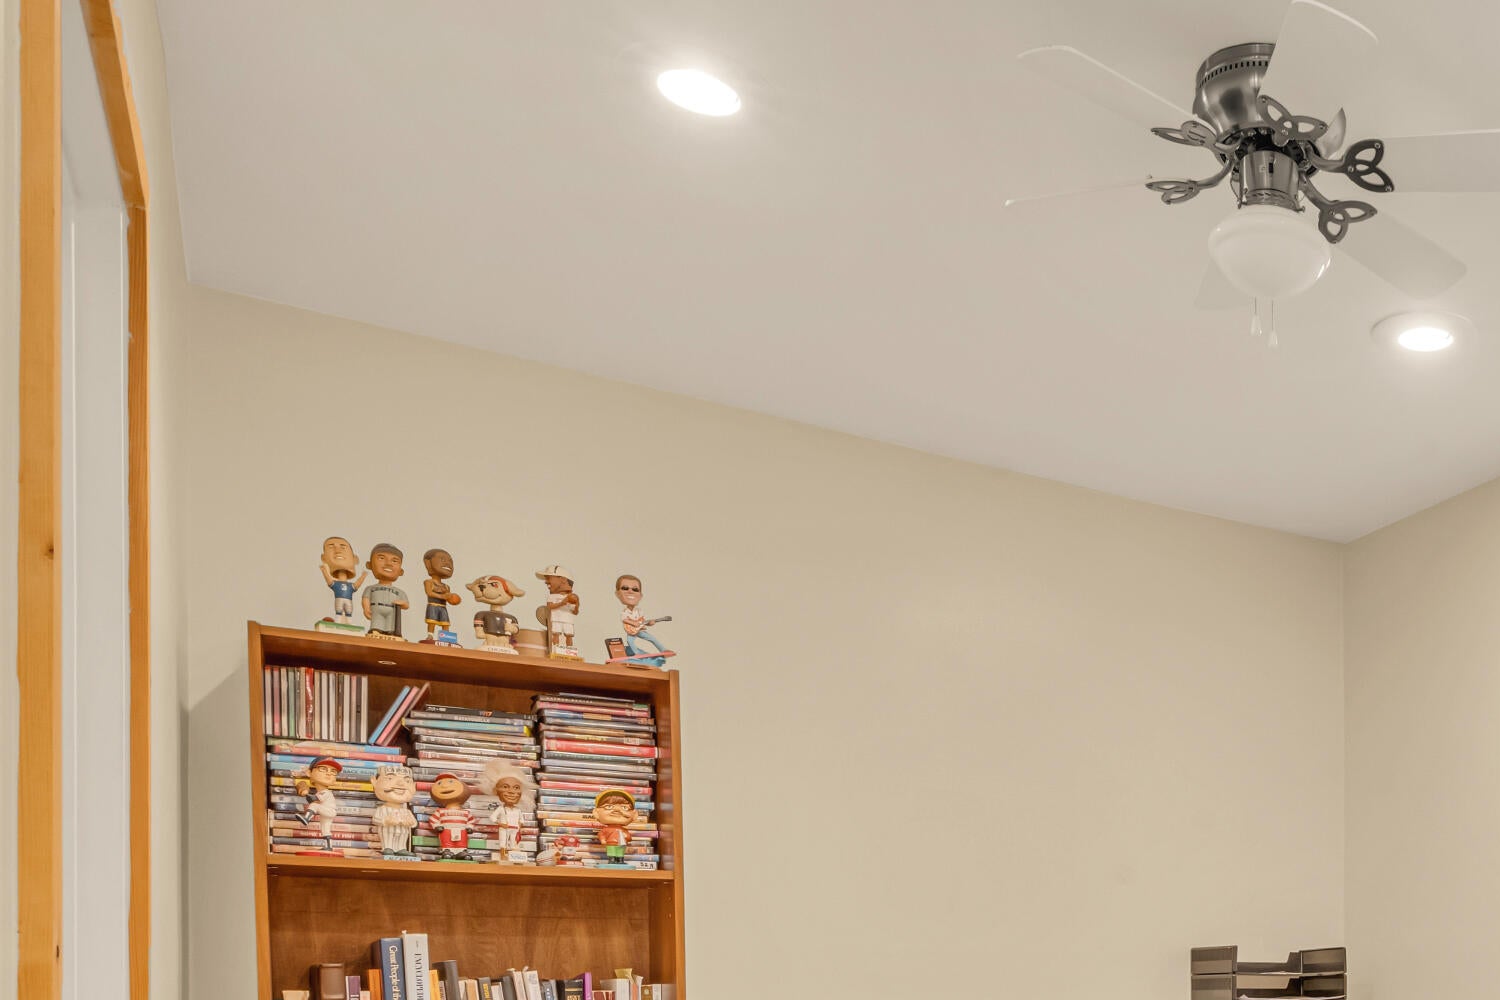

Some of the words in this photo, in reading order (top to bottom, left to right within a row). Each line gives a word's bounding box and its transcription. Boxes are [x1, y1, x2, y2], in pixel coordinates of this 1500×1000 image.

[389, 945, 398, 964] Great
[389, 964, 400, 985] People
[392, 985, 401, 993] of
